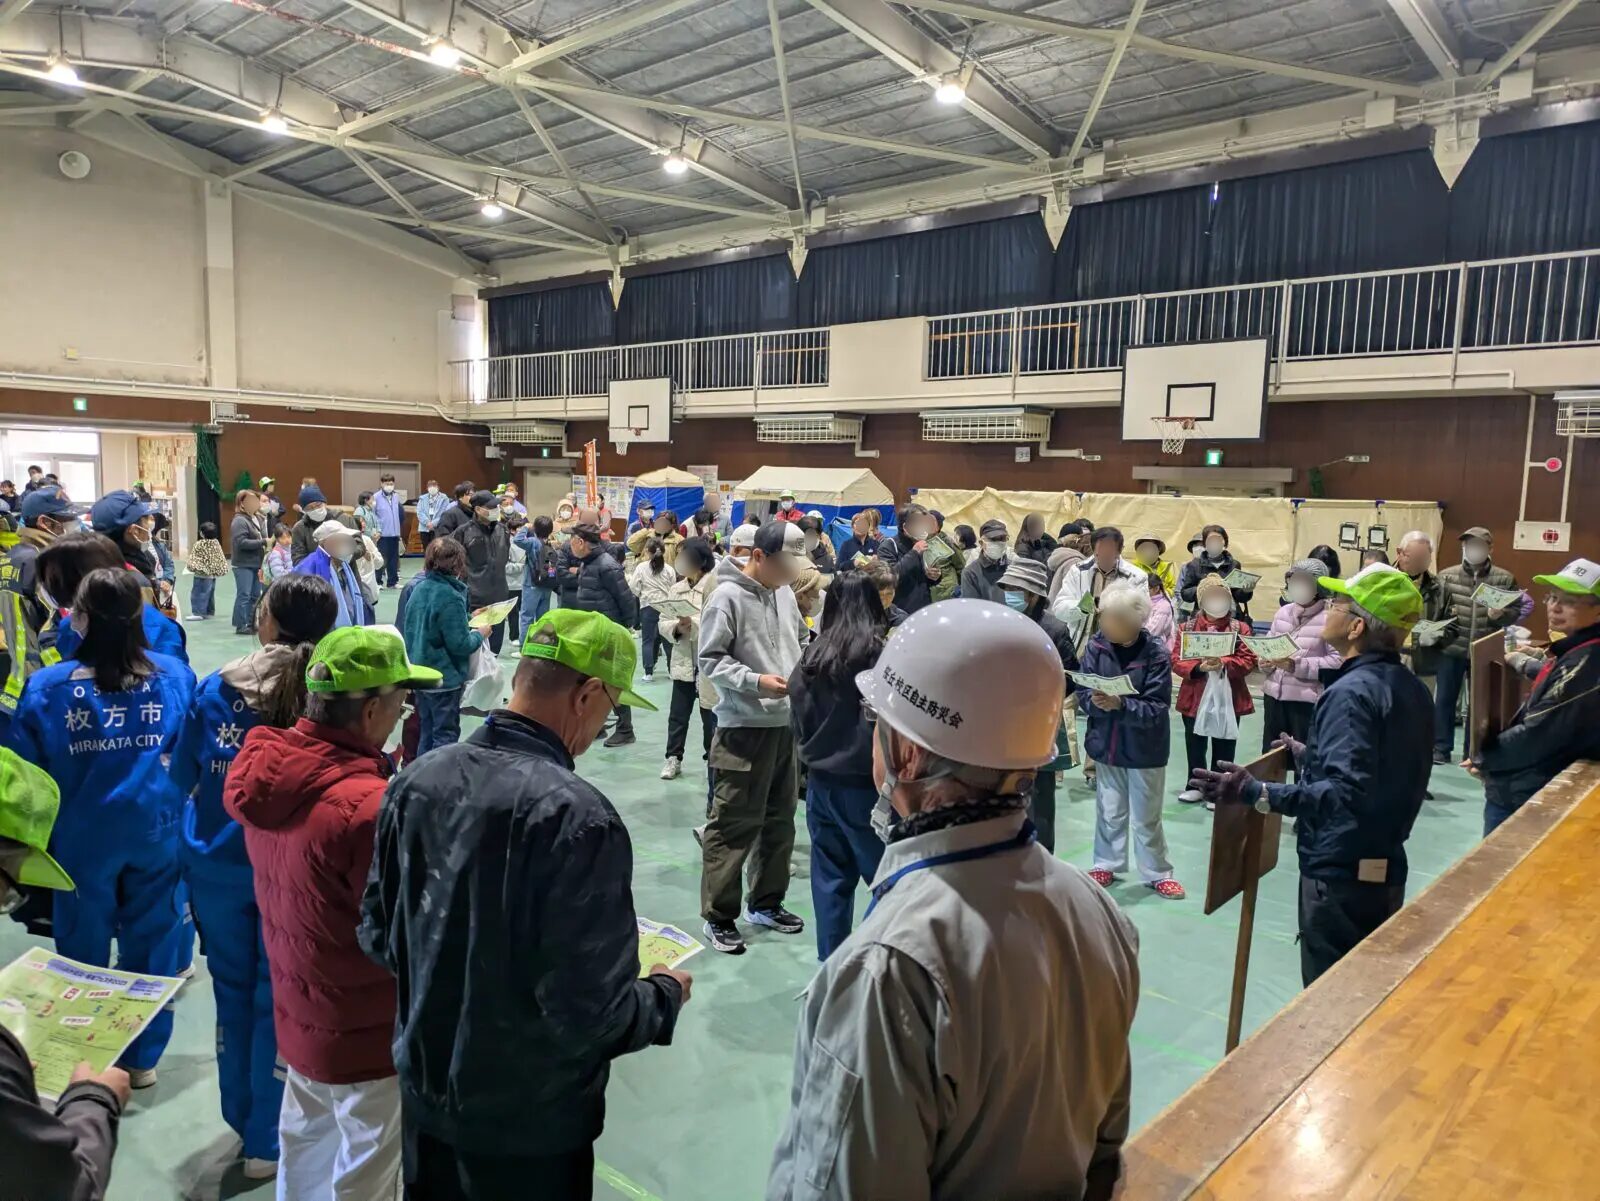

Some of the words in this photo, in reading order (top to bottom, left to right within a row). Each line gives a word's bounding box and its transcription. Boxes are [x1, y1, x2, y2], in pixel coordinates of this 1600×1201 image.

[64, 700, 164, 732] 枚方市
[69, 736, 132, 756] HIRAKATA
[135, 734, 165, 747] CITY
